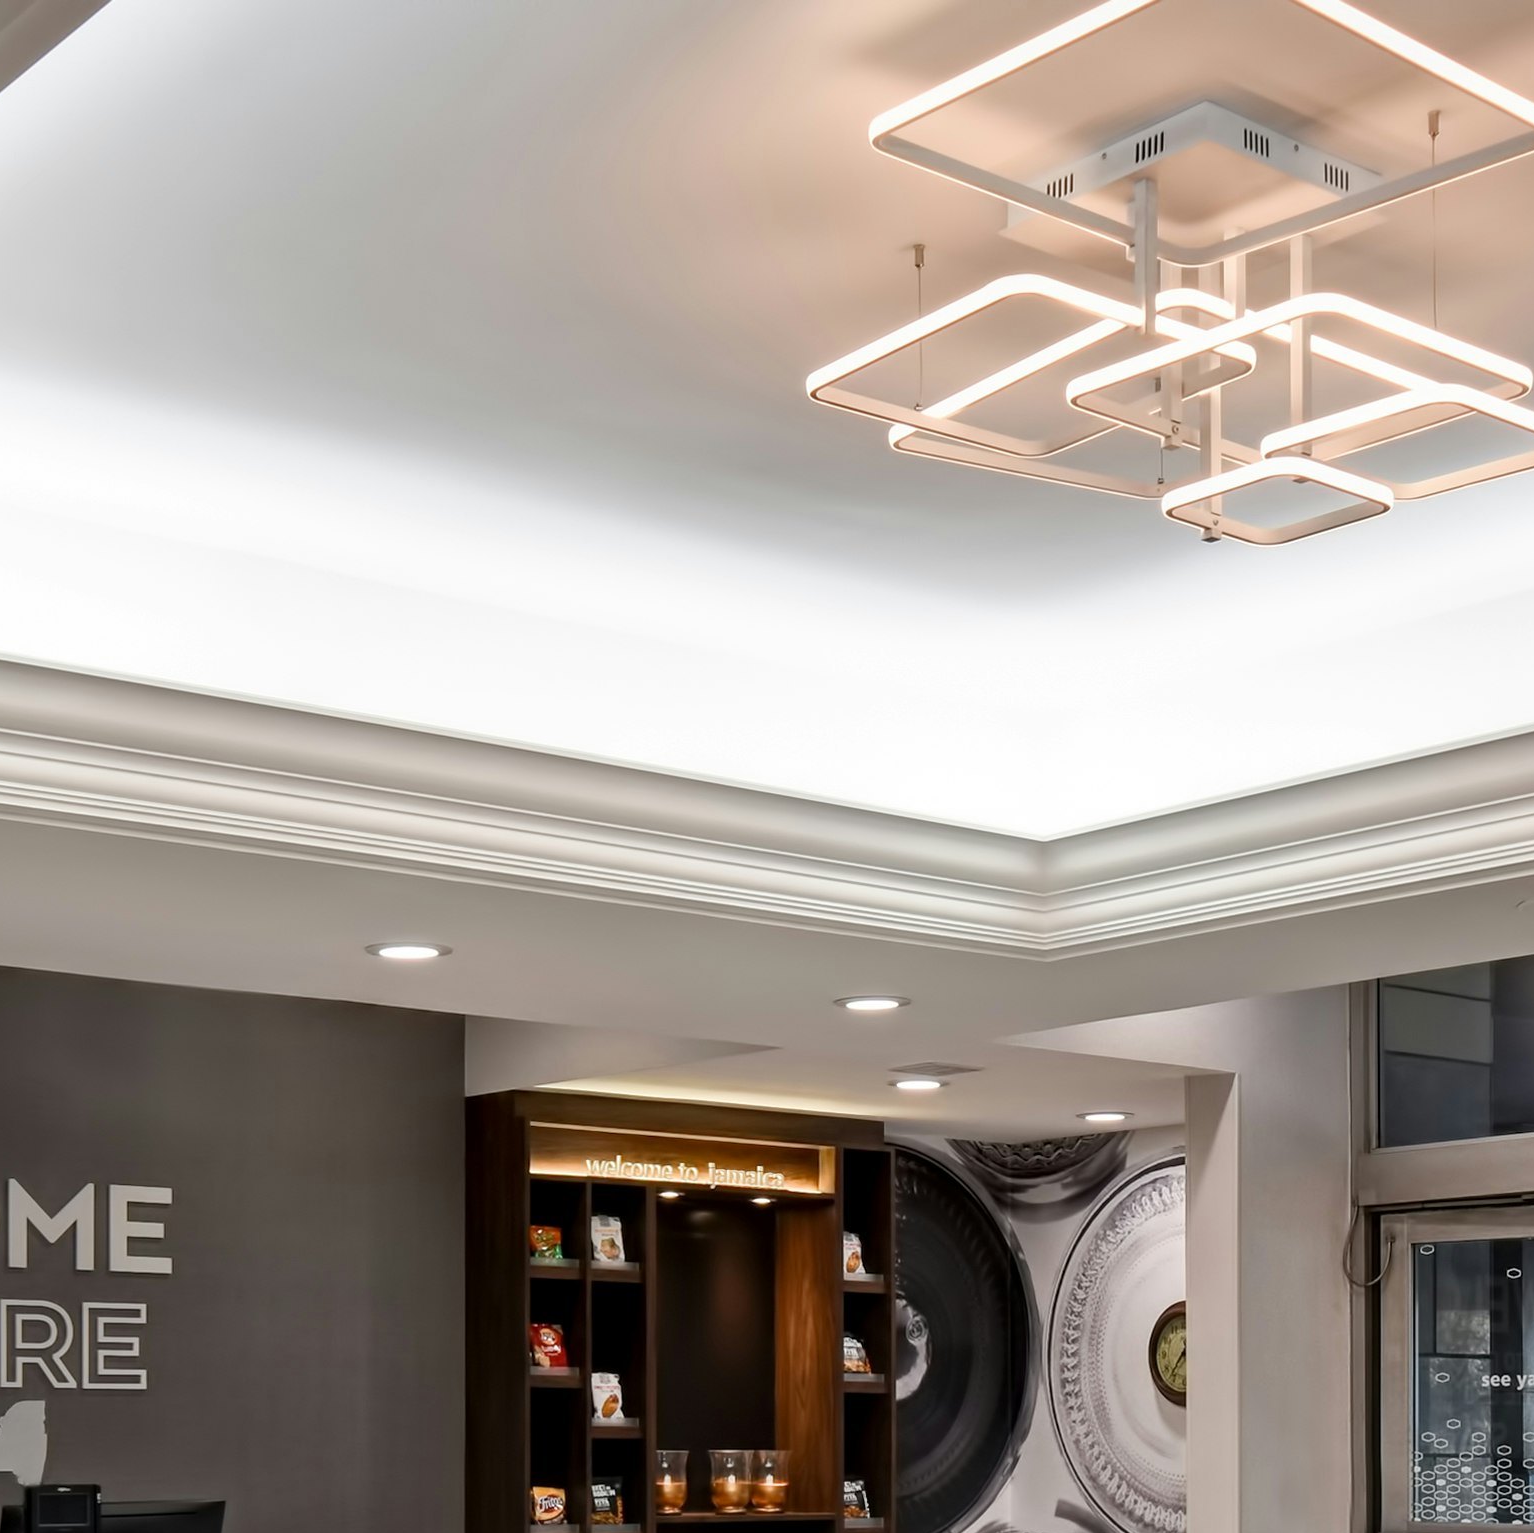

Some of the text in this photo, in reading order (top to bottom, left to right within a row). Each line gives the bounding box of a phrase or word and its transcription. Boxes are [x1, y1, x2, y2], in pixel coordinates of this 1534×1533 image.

[586, 1155, 784, 1190] welcome to jamaica
[1481, 1374, 1511, 1388] see
